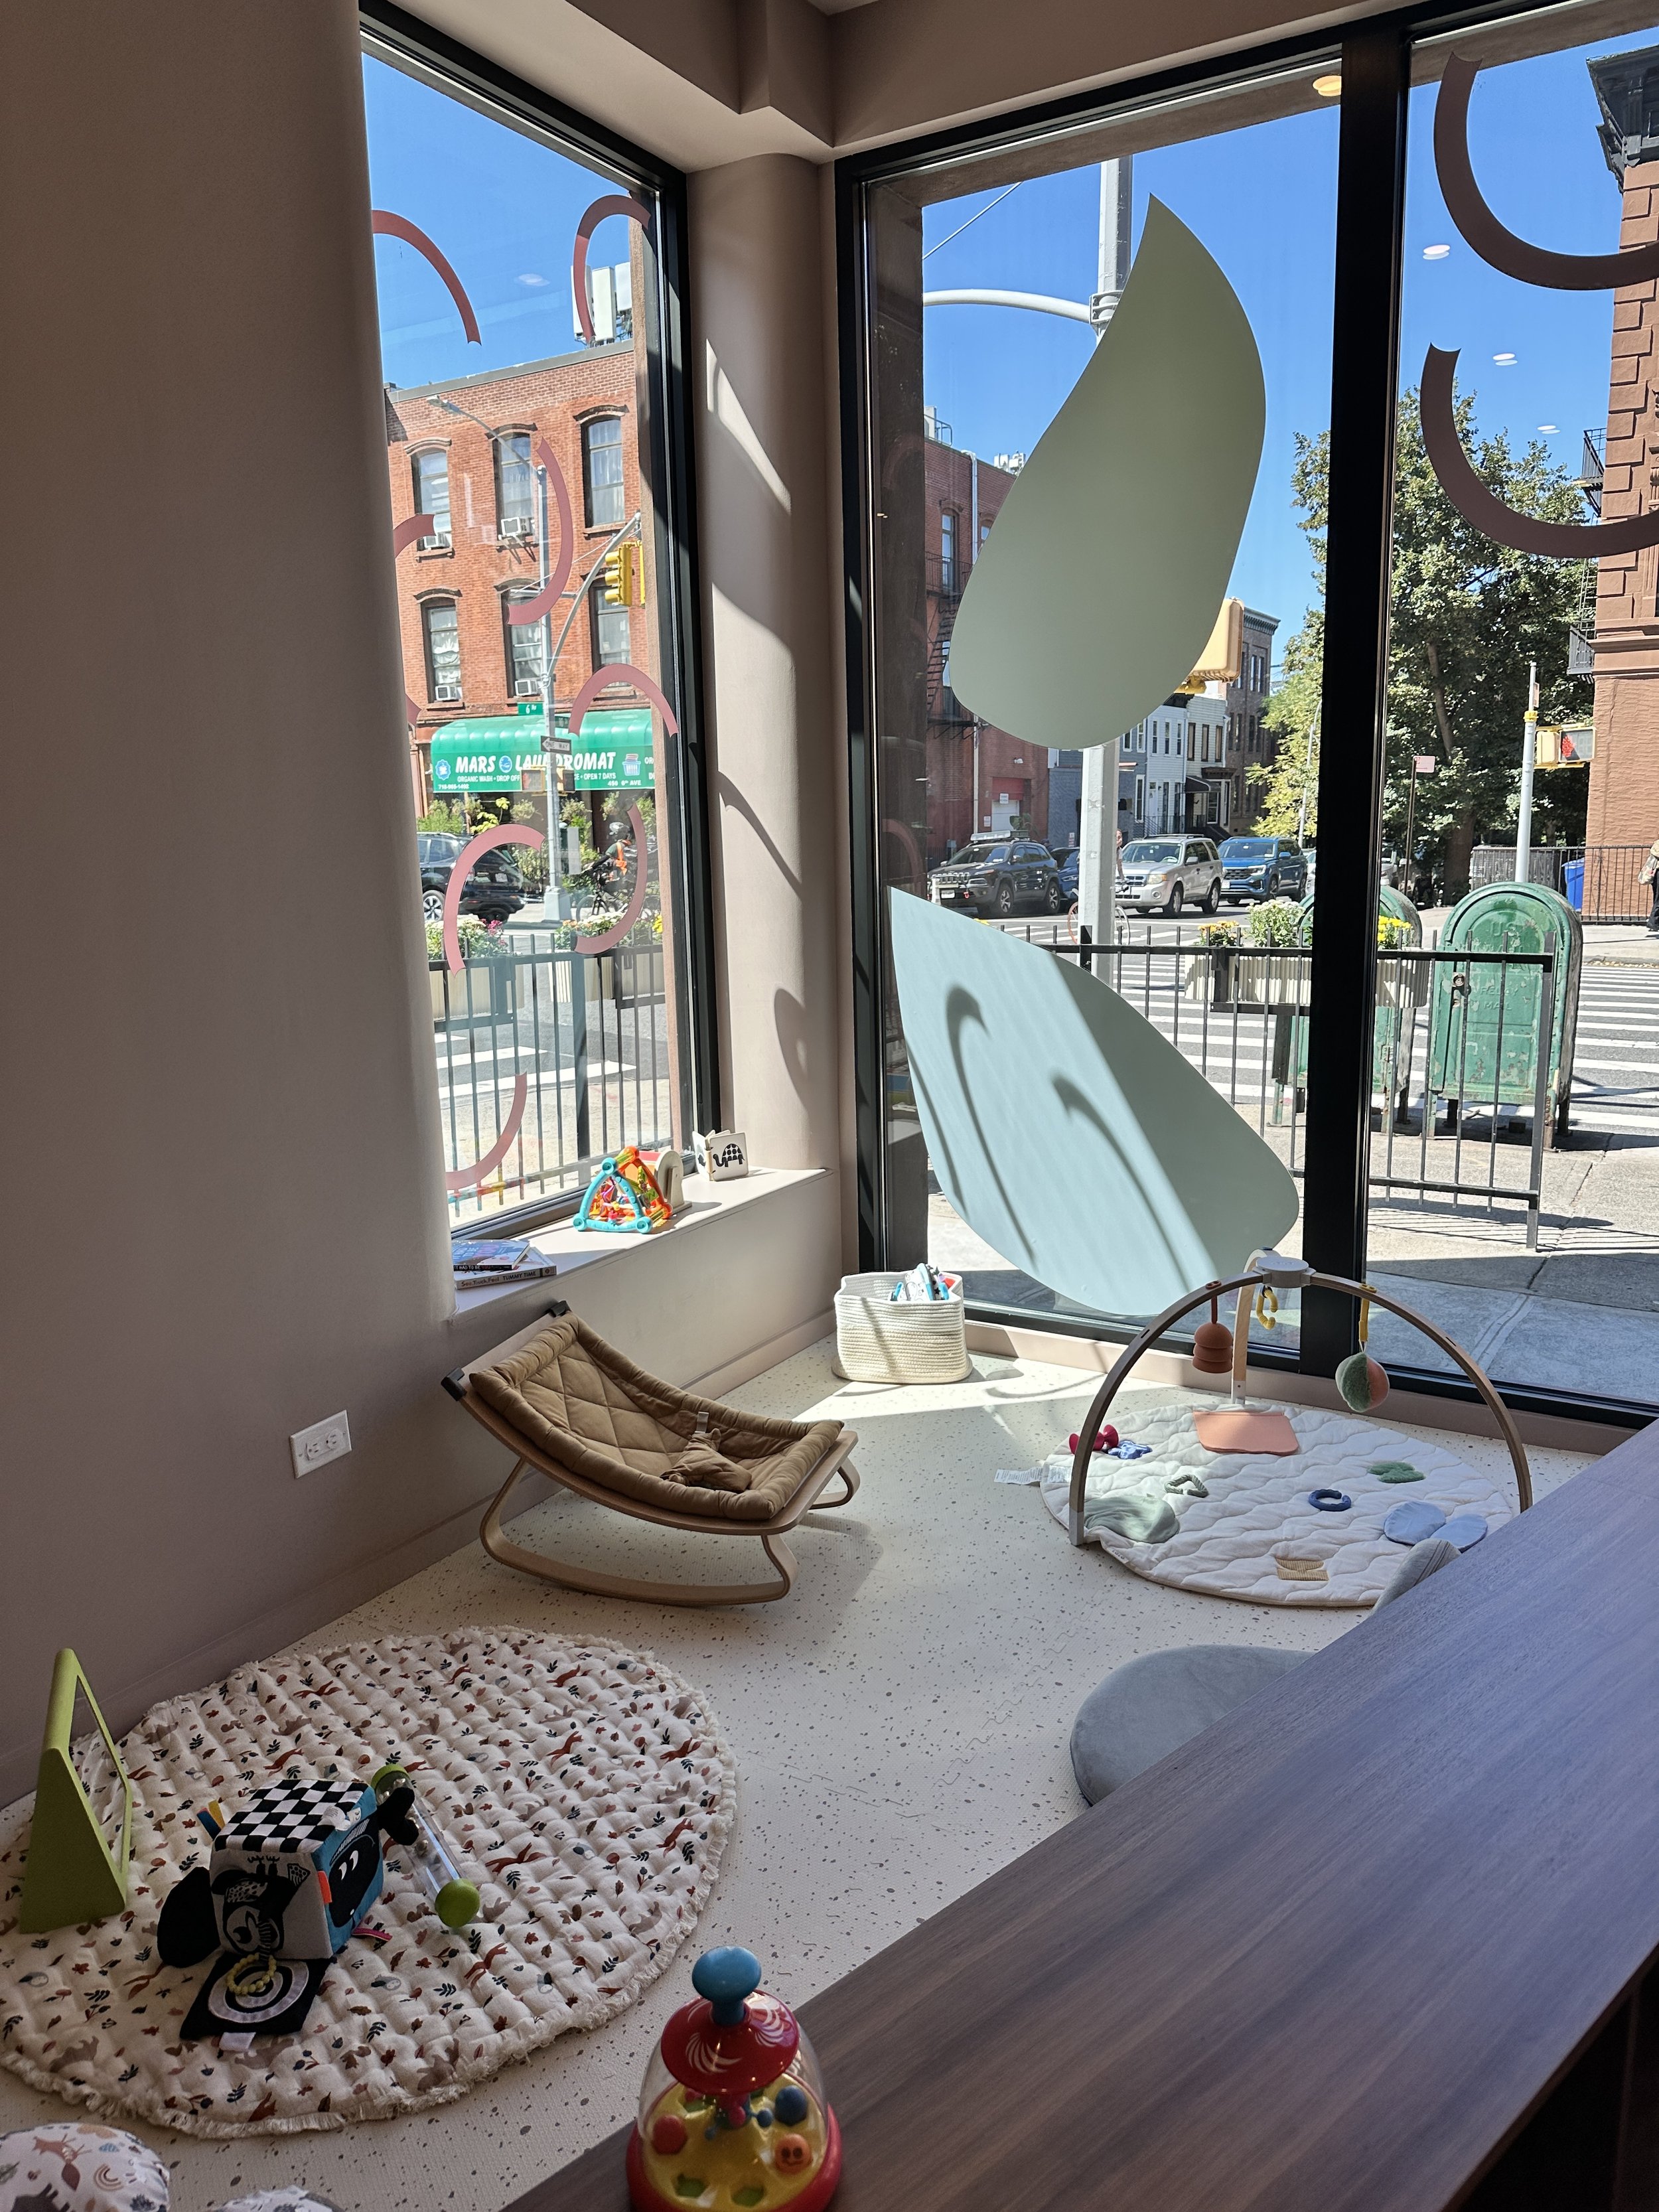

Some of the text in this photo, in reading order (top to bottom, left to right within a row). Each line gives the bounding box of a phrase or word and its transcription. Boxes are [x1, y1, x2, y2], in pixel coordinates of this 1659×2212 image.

[526, 704, 530, 714] 6
[455, 752, 616, 774] MARS LAUDROMAT
[1484, 1001, 1513, 1011] MAL
